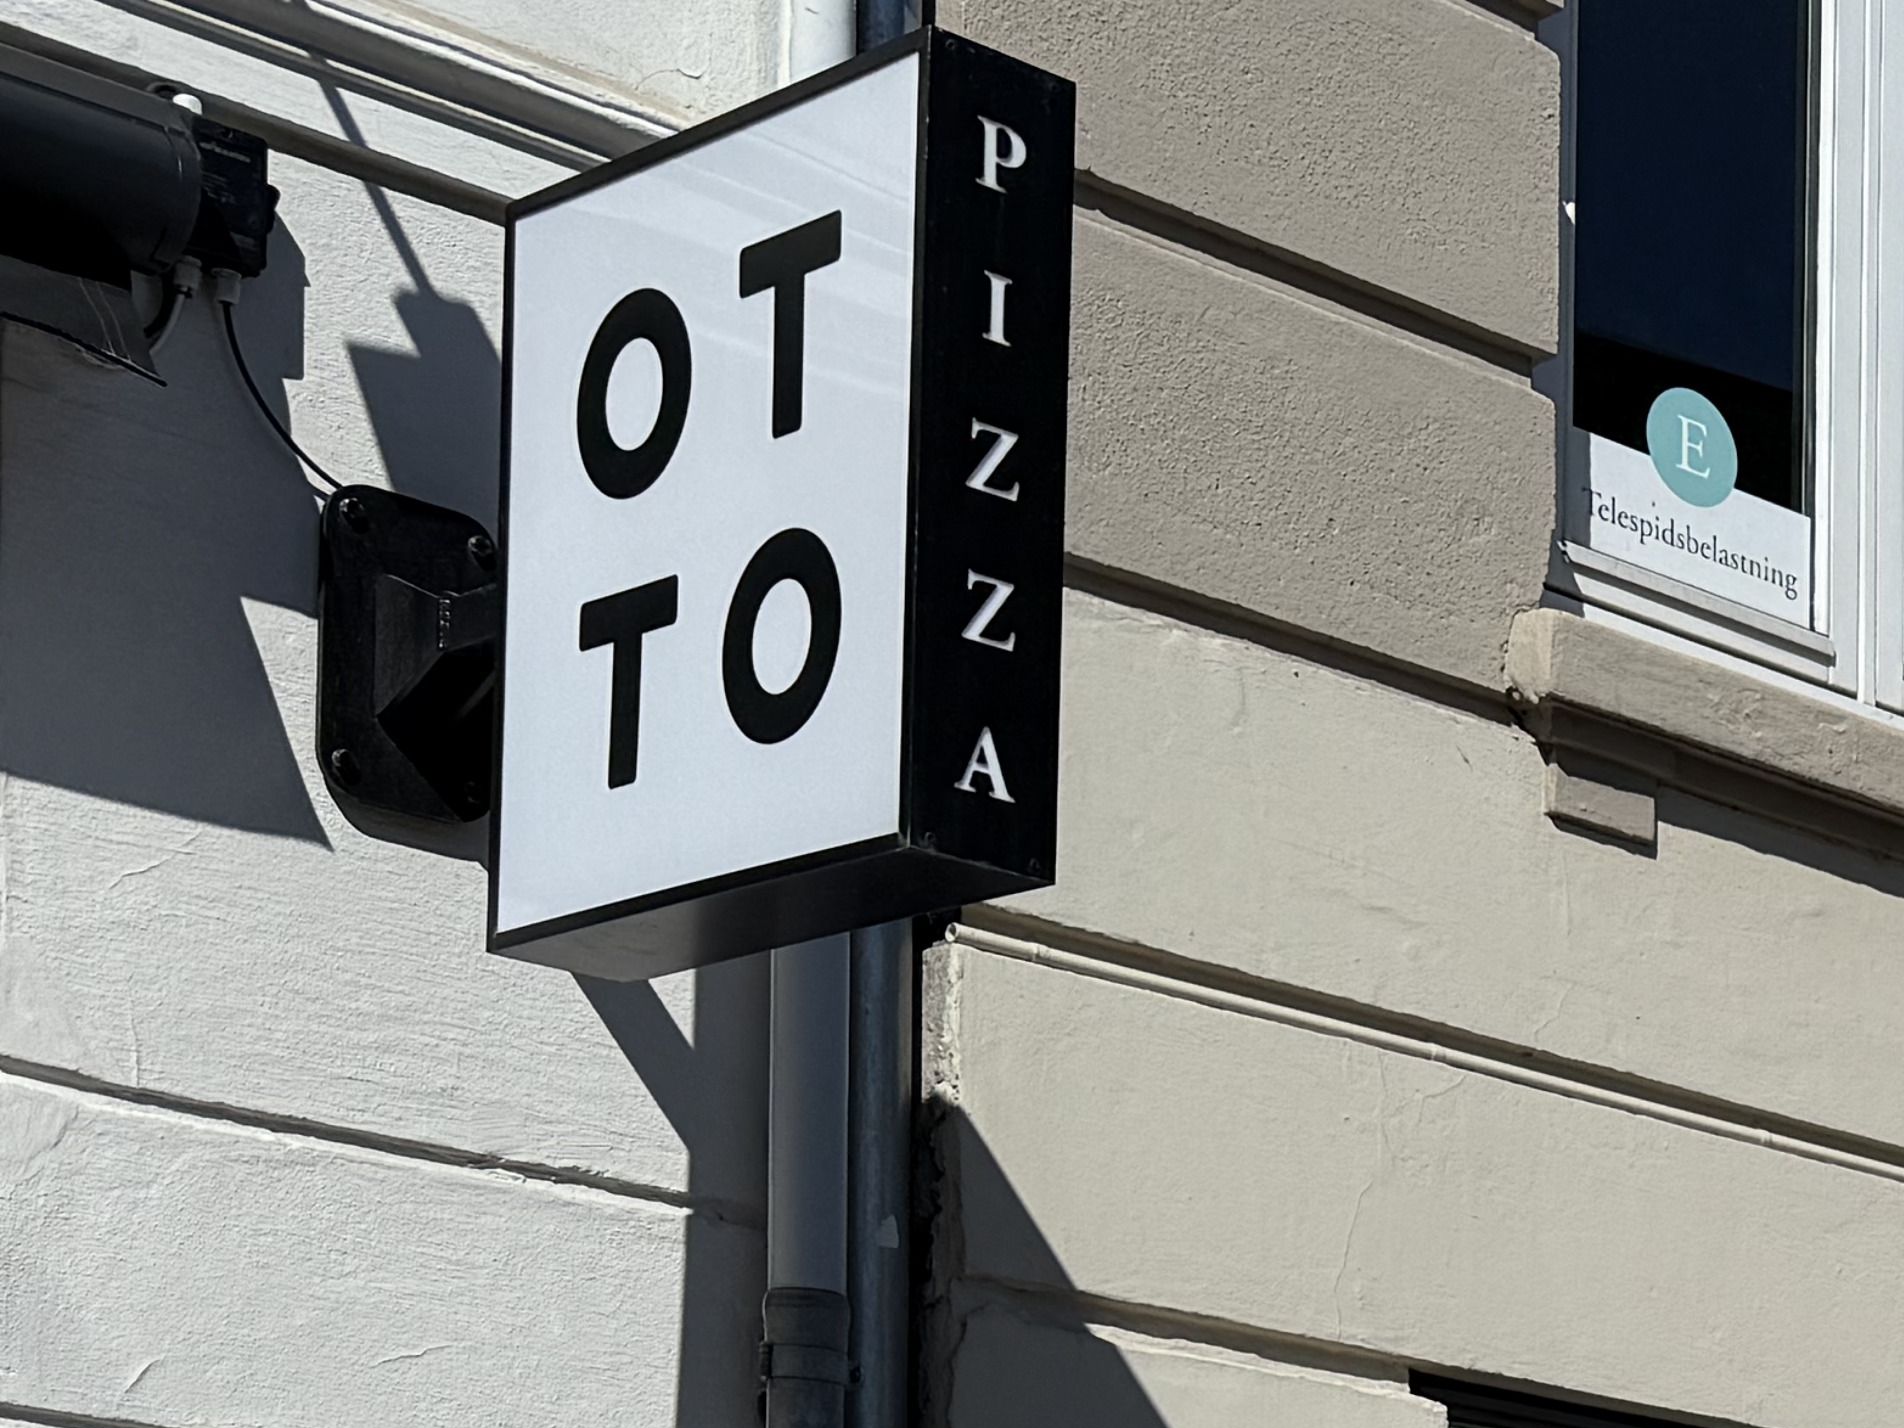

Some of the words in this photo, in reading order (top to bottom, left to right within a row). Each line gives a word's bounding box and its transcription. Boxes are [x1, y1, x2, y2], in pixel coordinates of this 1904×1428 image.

[954, 115, 1027, 804] PIZZA
[1675, 413, 1712, 480] E
[1582, 486, 1799, 601] Telespidsbelastning
